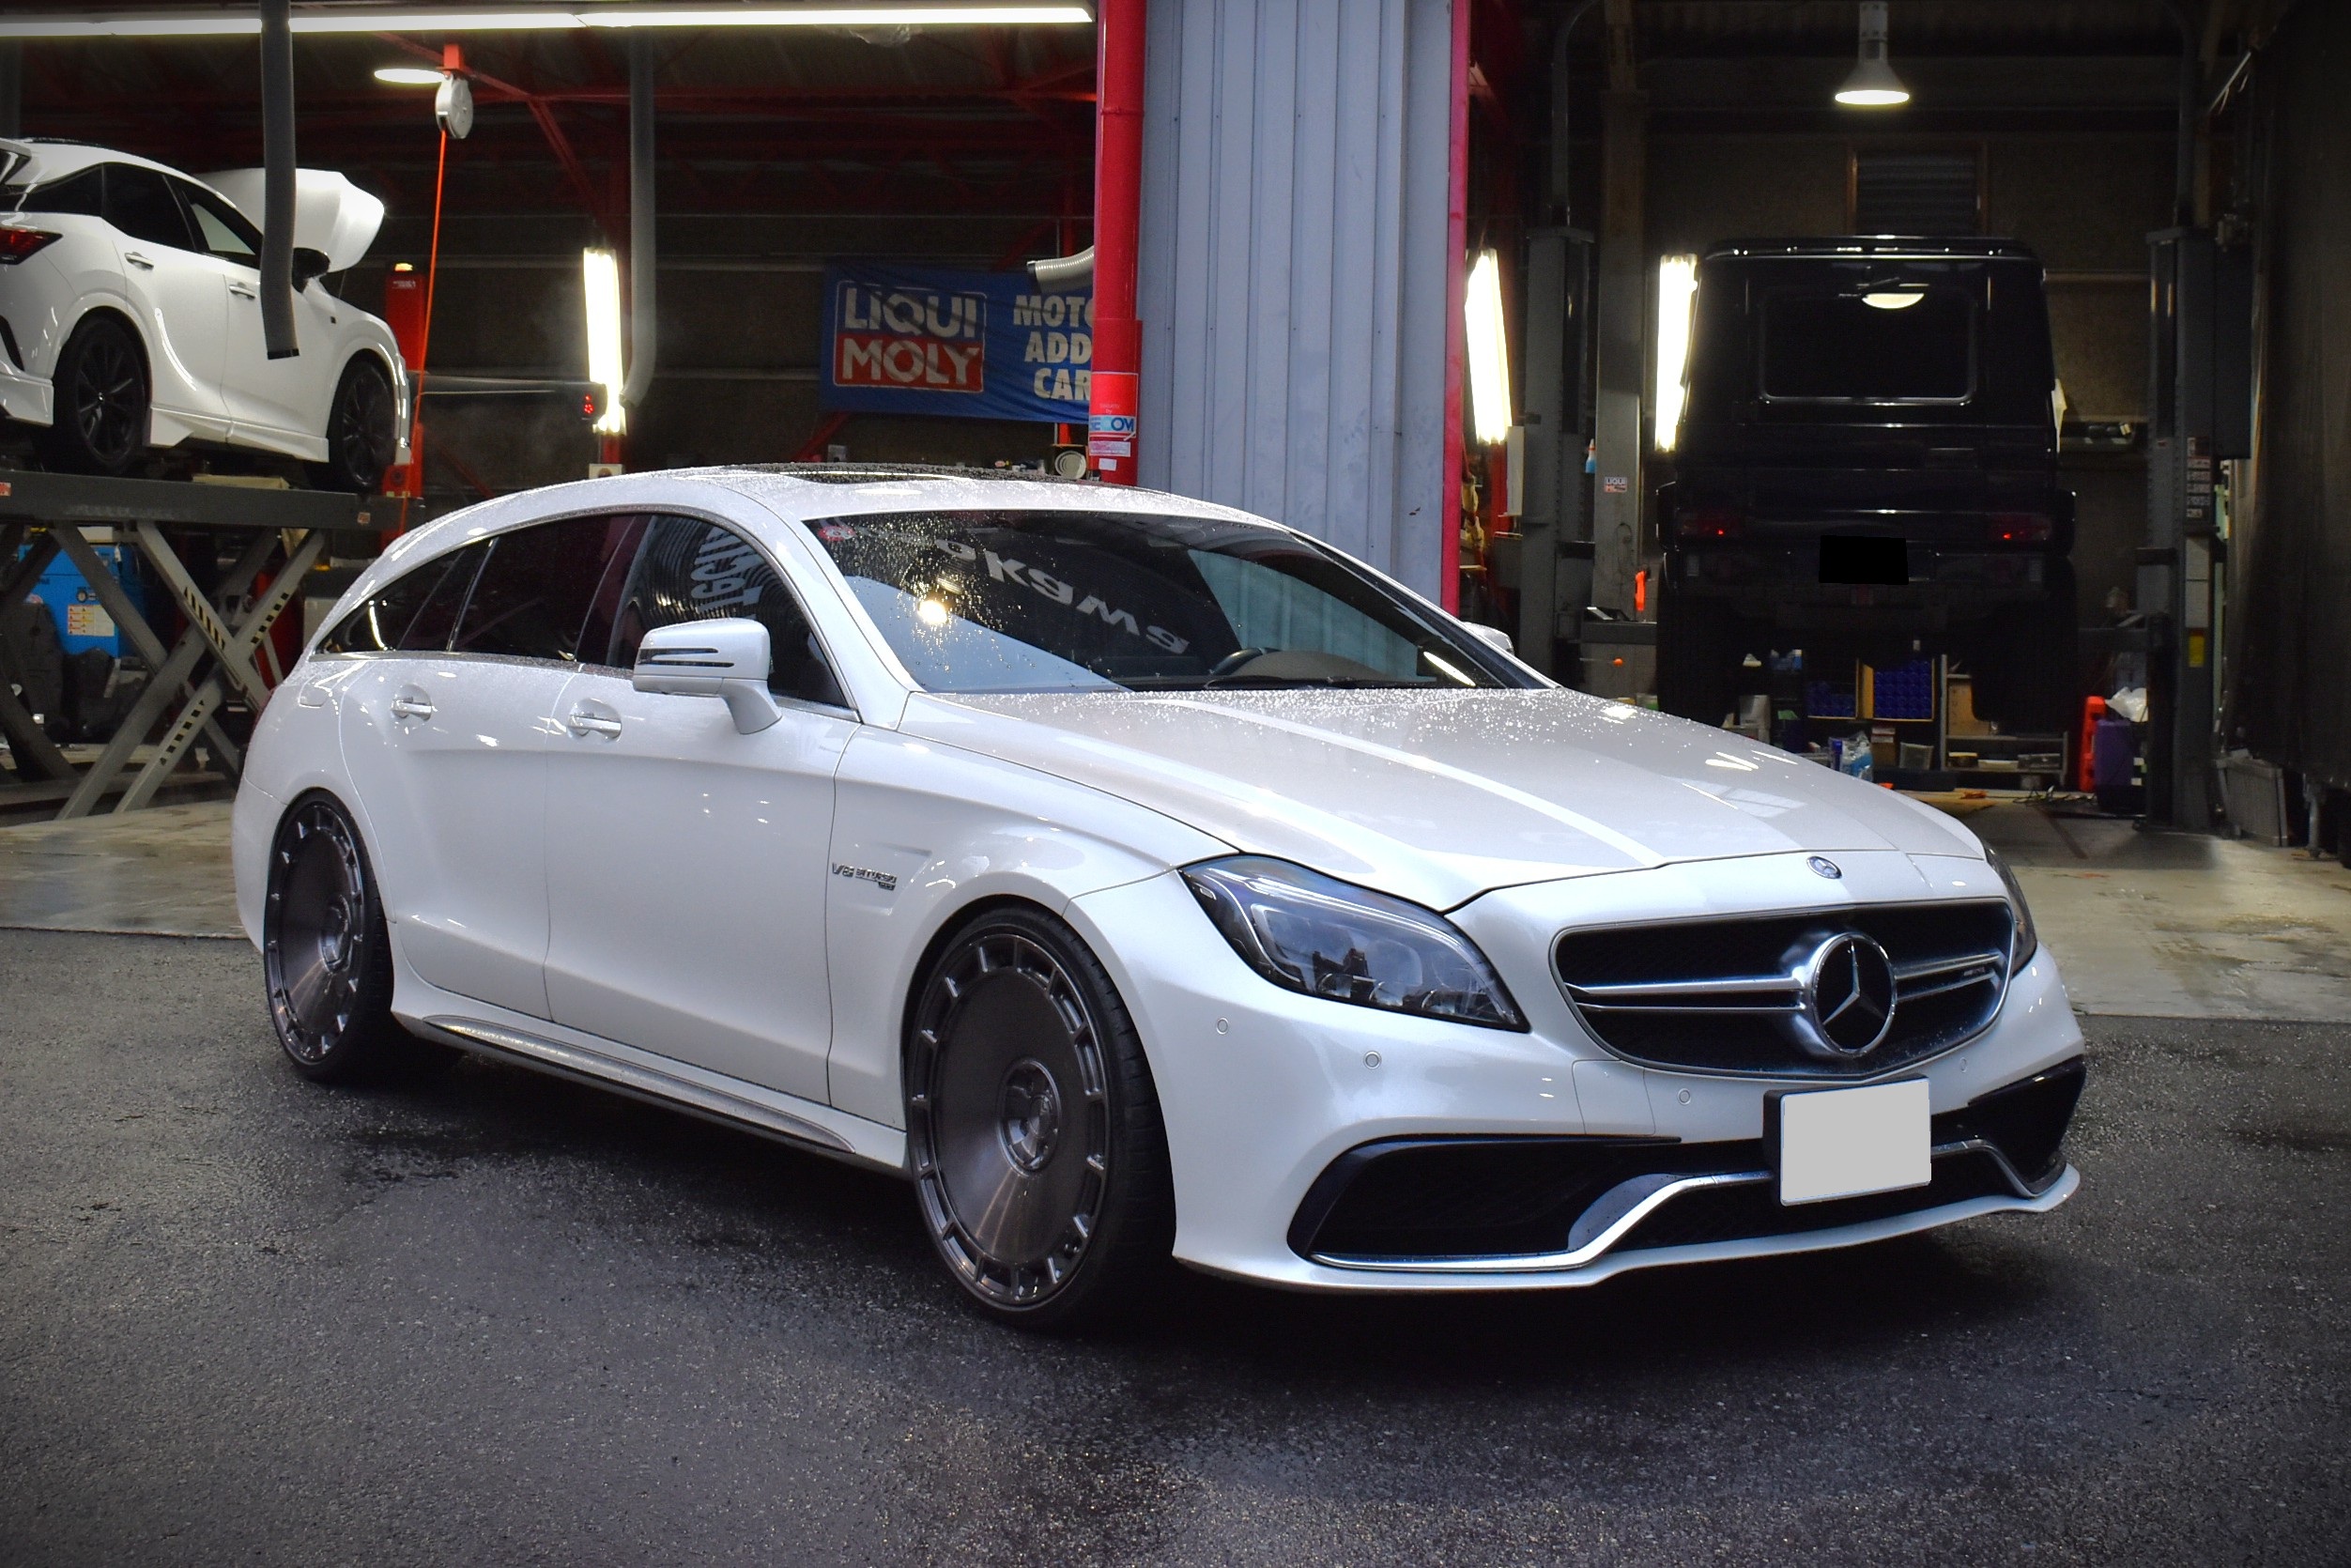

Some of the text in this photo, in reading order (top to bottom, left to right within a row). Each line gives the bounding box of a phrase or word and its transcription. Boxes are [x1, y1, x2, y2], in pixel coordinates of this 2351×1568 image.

[845, 287, 977, 338] LIQUI
[842, 338, 980, 385] MOLY
[1023, 331, 1092, 364] ADD
[1034, 367, 1091, 401] CAR
[1089, 417, 1134, 432] ECOM
[831, 863, 854, 878] V8
